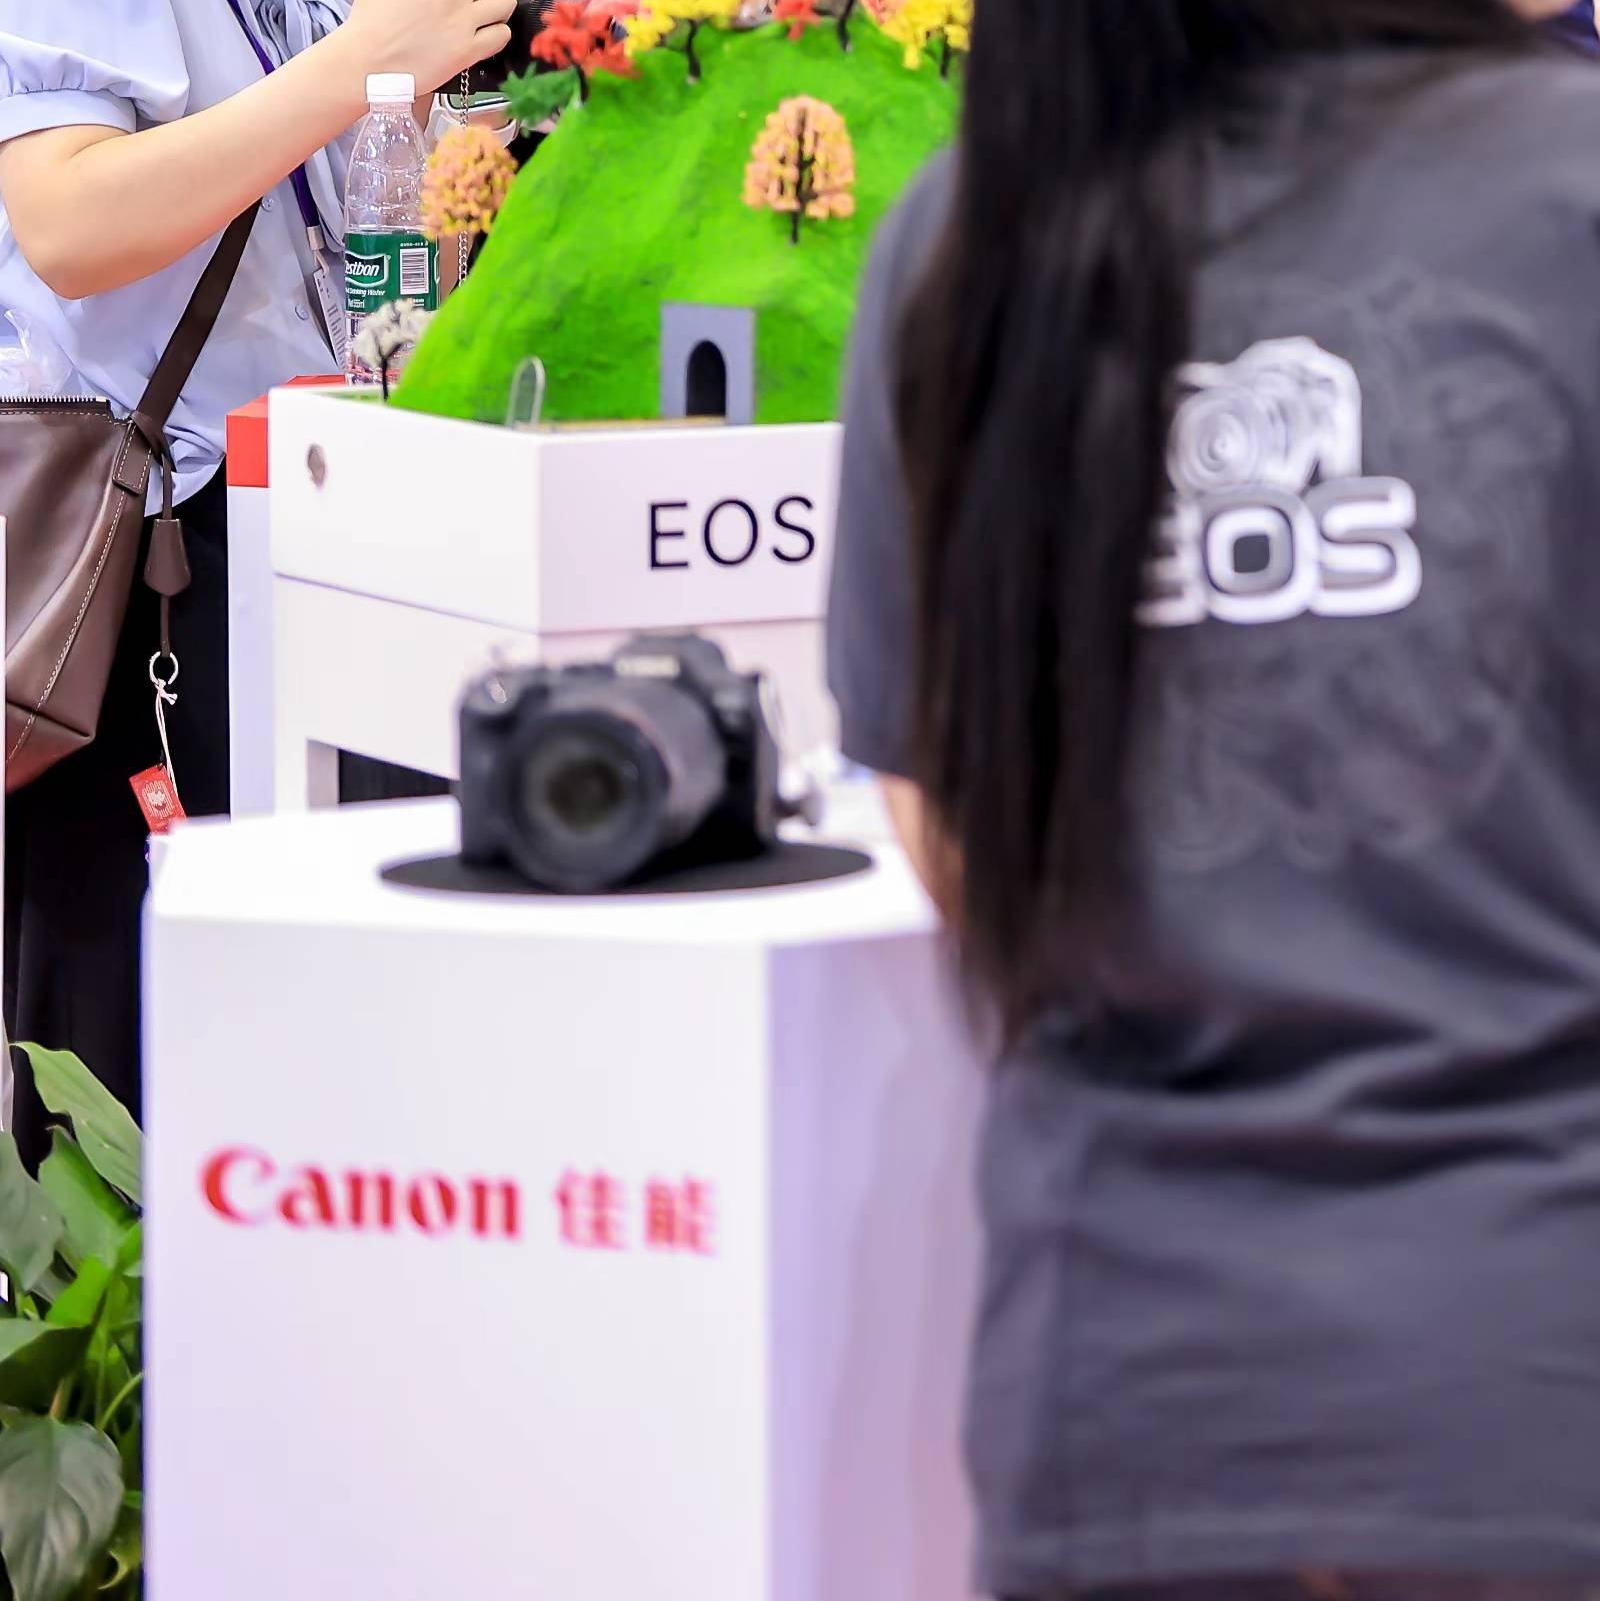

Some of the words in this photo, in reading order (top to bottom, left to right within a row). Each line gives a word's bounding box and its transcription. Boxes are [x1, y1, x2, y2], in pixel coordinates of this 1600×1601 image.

[647, 495, 817, 570] EOS
[199, 1145, 521, 1242] Canon
[555, 1165, 716, 1255] 佳能
